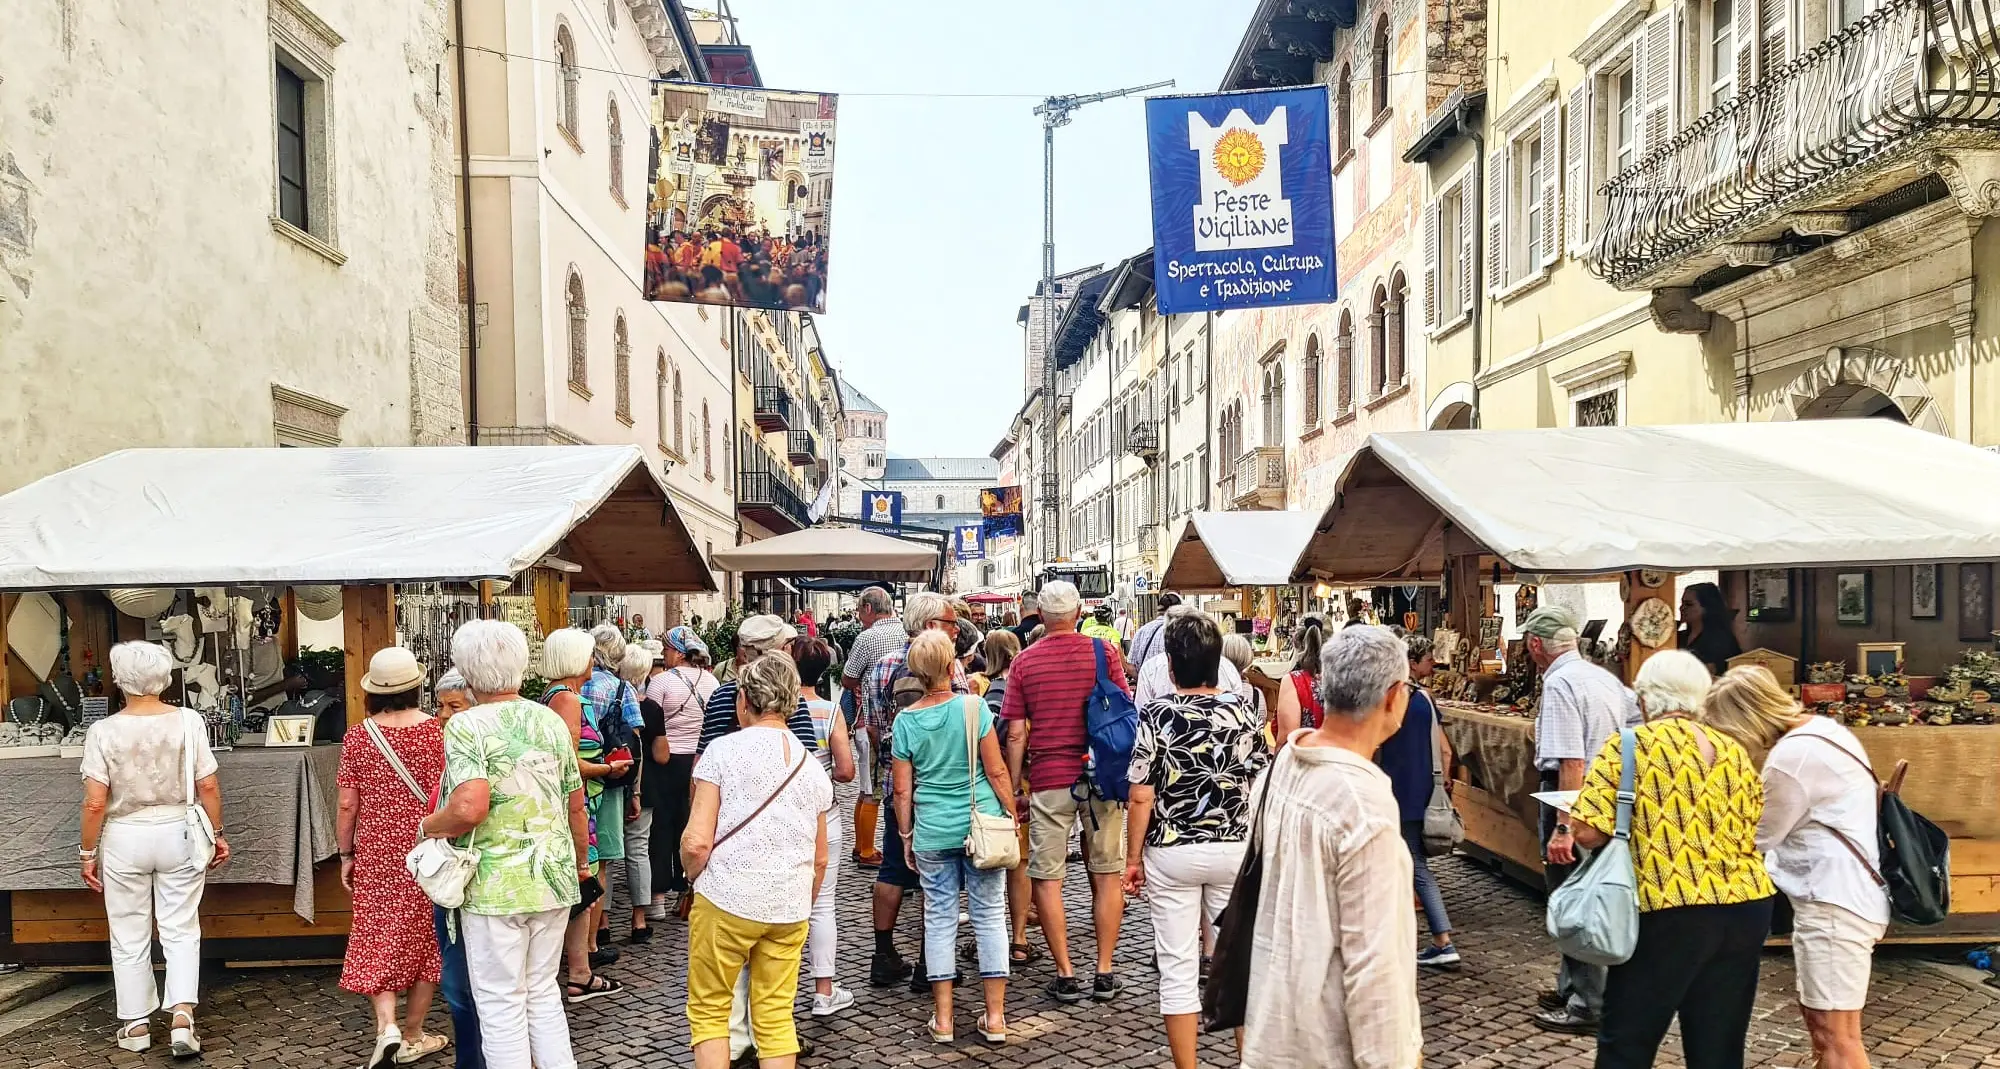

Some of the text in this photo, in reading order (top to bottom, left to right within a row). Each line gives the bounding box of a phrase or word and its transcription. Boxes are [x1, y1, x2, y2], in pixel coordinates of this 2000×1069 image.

[1213, 189, 1271, 214] Feste
[1198, 214, 1290, 247] Vigiliane
[1167, 253, 1324, 283] Spettacolo, Cultura
[1199, 277, 1294, 302] e Tradizione
